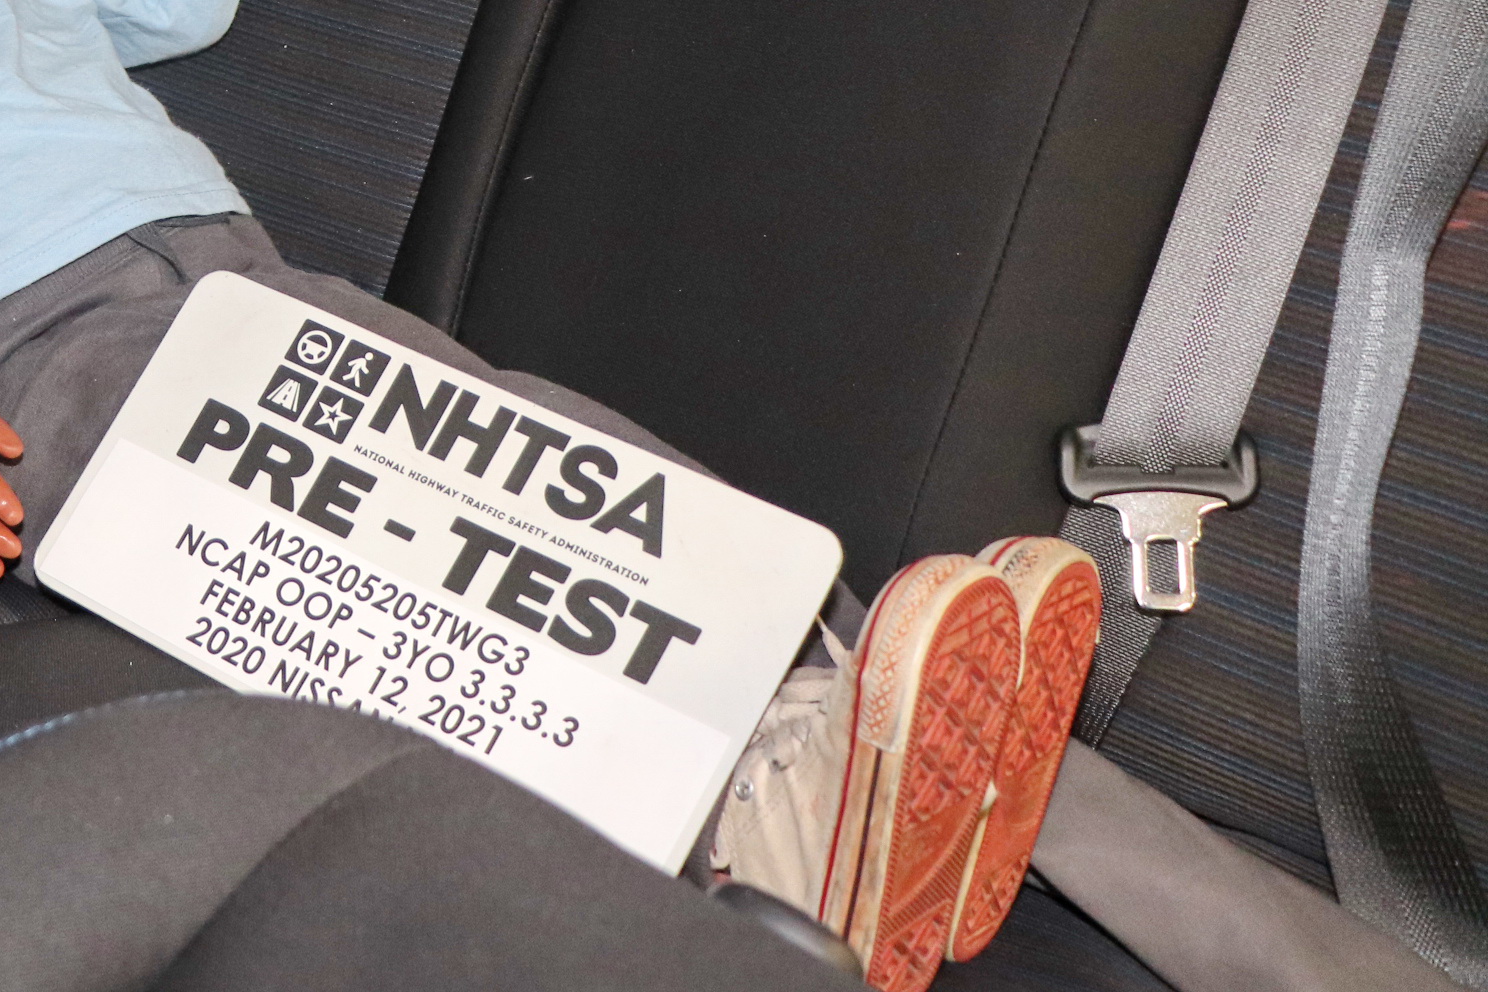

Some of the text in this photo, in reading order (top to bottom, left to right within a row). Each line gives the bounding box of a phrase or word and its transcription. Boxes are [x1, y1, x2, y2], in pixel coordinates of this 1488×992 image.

[176, 398, 379, 540] PRE
[441, 516, 702, 685] TEST
[353, 444, 650, 587] NATIONAL HIGHWAY TRAFFIC SAFETY ADMINISTRATION
[368, 362, 666, 559] NHTSA
[175, 523, 271, 586] NCAP
[275, 577, 354, 629] OOP
[382, 631, 455, 683] 3YO
[460, 669, 580, 747] 3.3.3.3
[185, 616, 266, 675] 2020
[199, 578, 363, 679] FEBRUARY
[368, 665, 409, 714] 12,
[417, 694, 504, 755] 2021
[249, 520, 531, 676] M20205205TWG3
